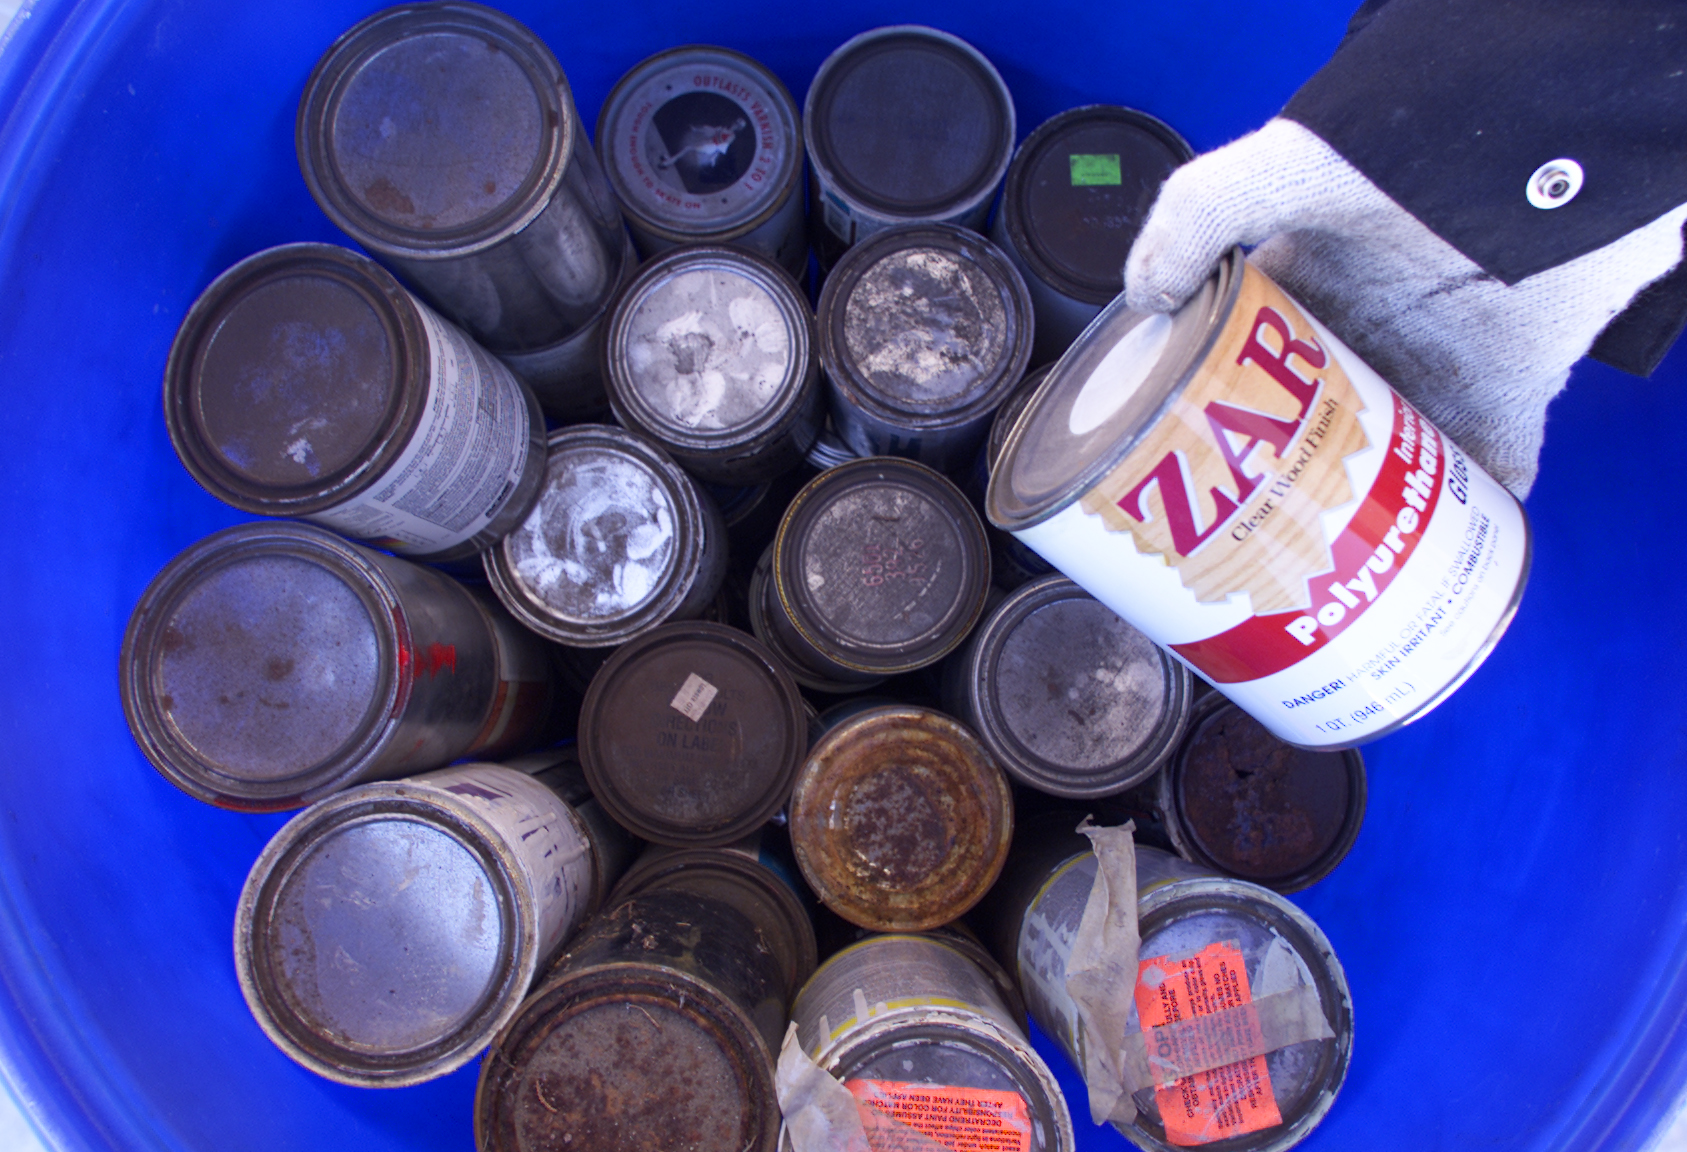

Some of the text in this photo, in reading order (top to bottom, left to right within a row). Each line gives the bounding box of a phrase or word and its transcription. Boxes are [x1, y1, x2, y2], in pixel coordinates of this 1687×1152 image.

[694, 75, 750, 102] OUTLASTS
[751, 101, 774, 150] VARNISH
[751, 167, 766, 183] TO
[759, 156, 770, 164] 2
[1116, 305, 1331, 558] ZAR
[1231, 397, 1339, 542] Clear Wood Finish
[1281, 678, 1347, 709] DANGER!
[1346, 641, 1400, 682] HARMFUL
[1400, 620, 1418, 639] OR
[1416, 591, 1445, 621] FATAL
[1448, 506, 1479, 577] SWALLOWED
[1370, 513, 1490, 680] SKIN IRRITANT COMBUSTIBLE
[1315, 681, 1416, 734] 1 QT. (946 mL)
